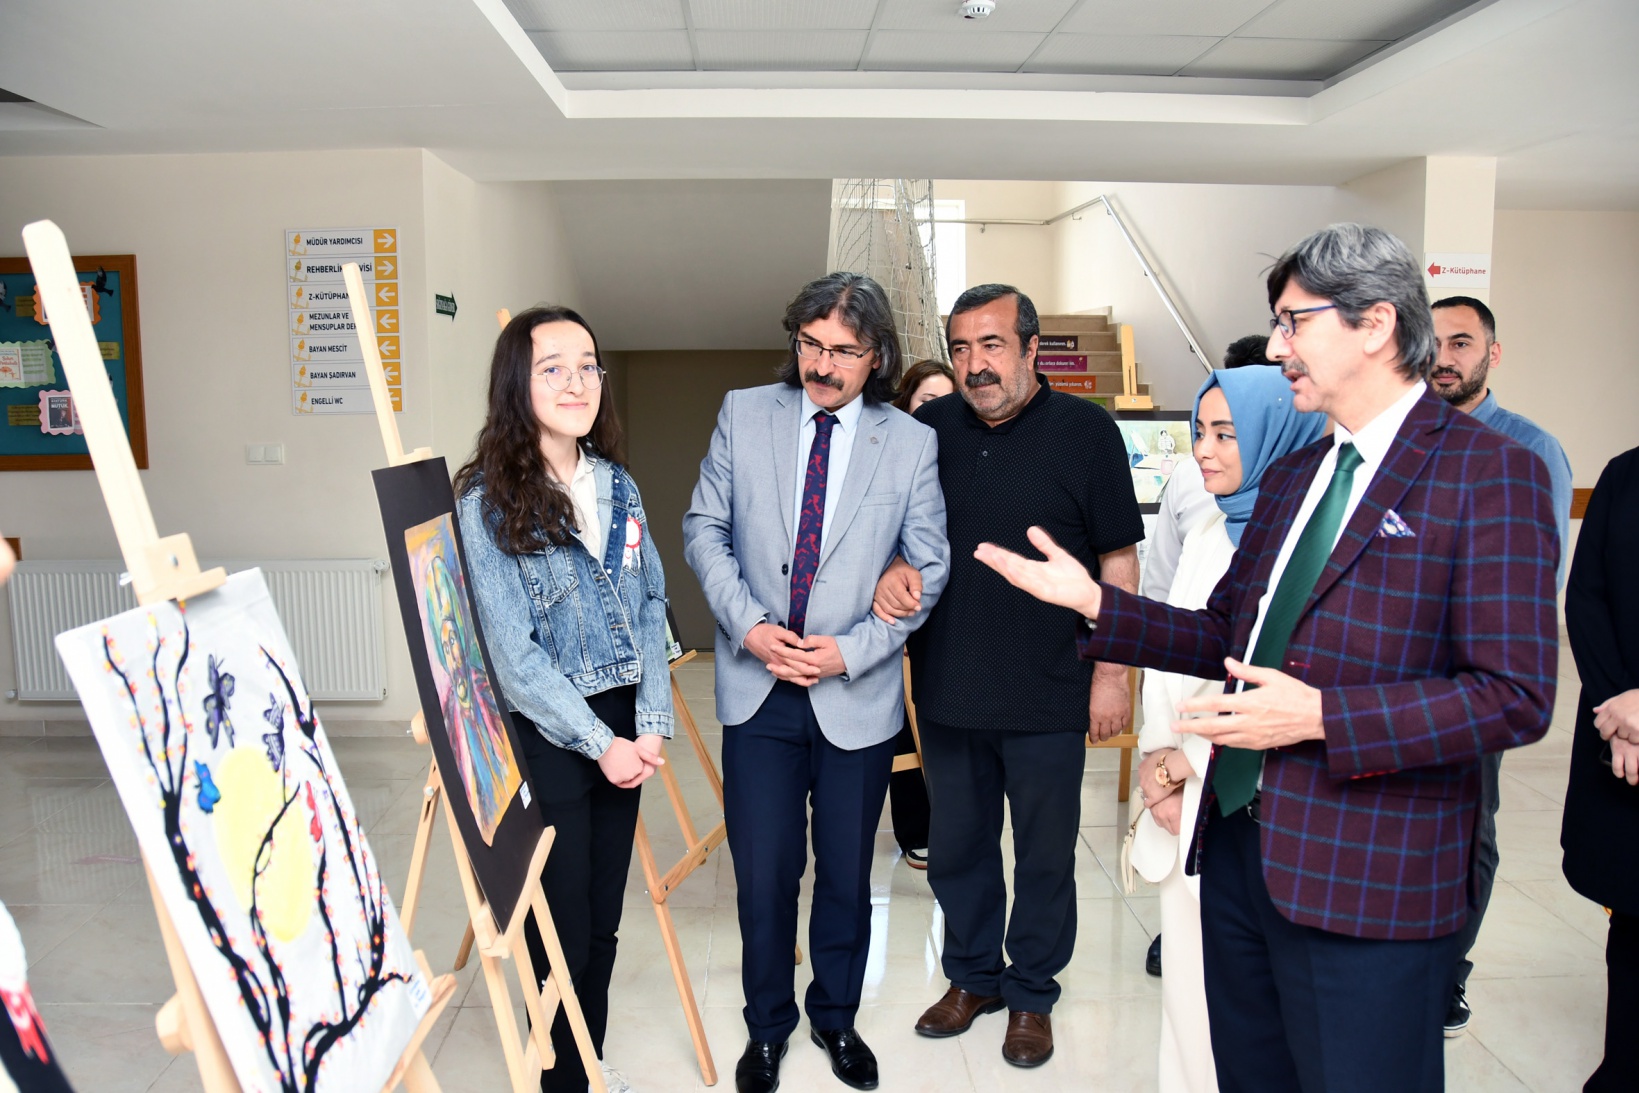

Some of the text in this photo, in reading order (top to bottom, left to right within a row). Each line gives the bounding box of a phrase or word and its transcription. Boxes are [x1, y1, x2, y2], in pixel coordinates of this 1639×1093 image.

[306, 237, 363, 246] MÜDÜR YARDIMCISI
[1442, 267, 1486, 275] Z-Kütüphane
[308, 292, 349, 300] Z-KÜTÜPHAN
[341, 312, 349, 320] VE
[327, 343, 347, 352] MESCİT
[310, 371, 356, 380] BAYAN ŞADIRVAN
[311, 396, 343, 405] ENGELLİ WC
